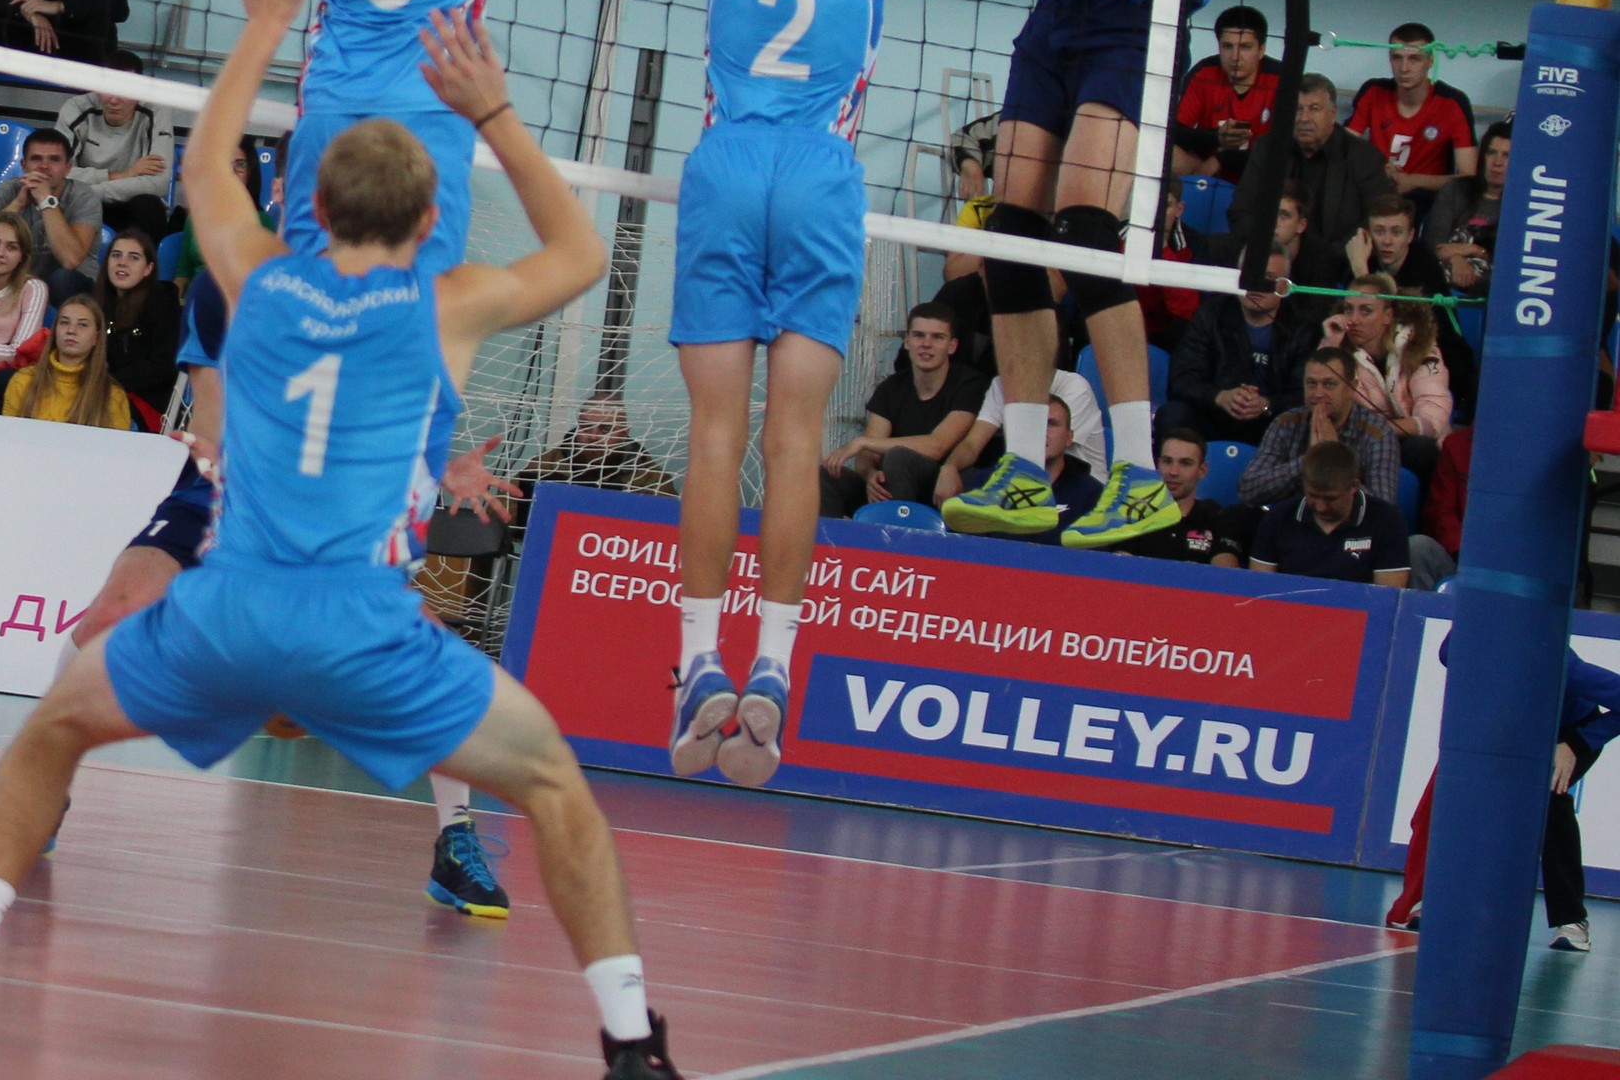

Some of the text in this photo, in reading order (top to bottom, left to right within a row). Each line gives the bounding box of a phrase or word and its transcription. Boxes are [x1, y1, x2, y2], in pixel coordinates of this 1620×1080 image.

[1538, 65, 1579, 84] FIVB
[1389, 133, 1414, 169] 5
[1516, 165, 1568, 327] JINLING
[284, 353, 343, 477] 1
[577, 532, 936, 599] ОФИЦЛЬЙ САЙТ
[1344, 538, 1372, 551] PUMA
[570, 569, 1255, 679] ВСЕРОСИЙОЙ ФЕДЕРАЦИИ ВОЛЕЙБОЛА
[845, 674, 1314, 786] VOLLEY.RU
